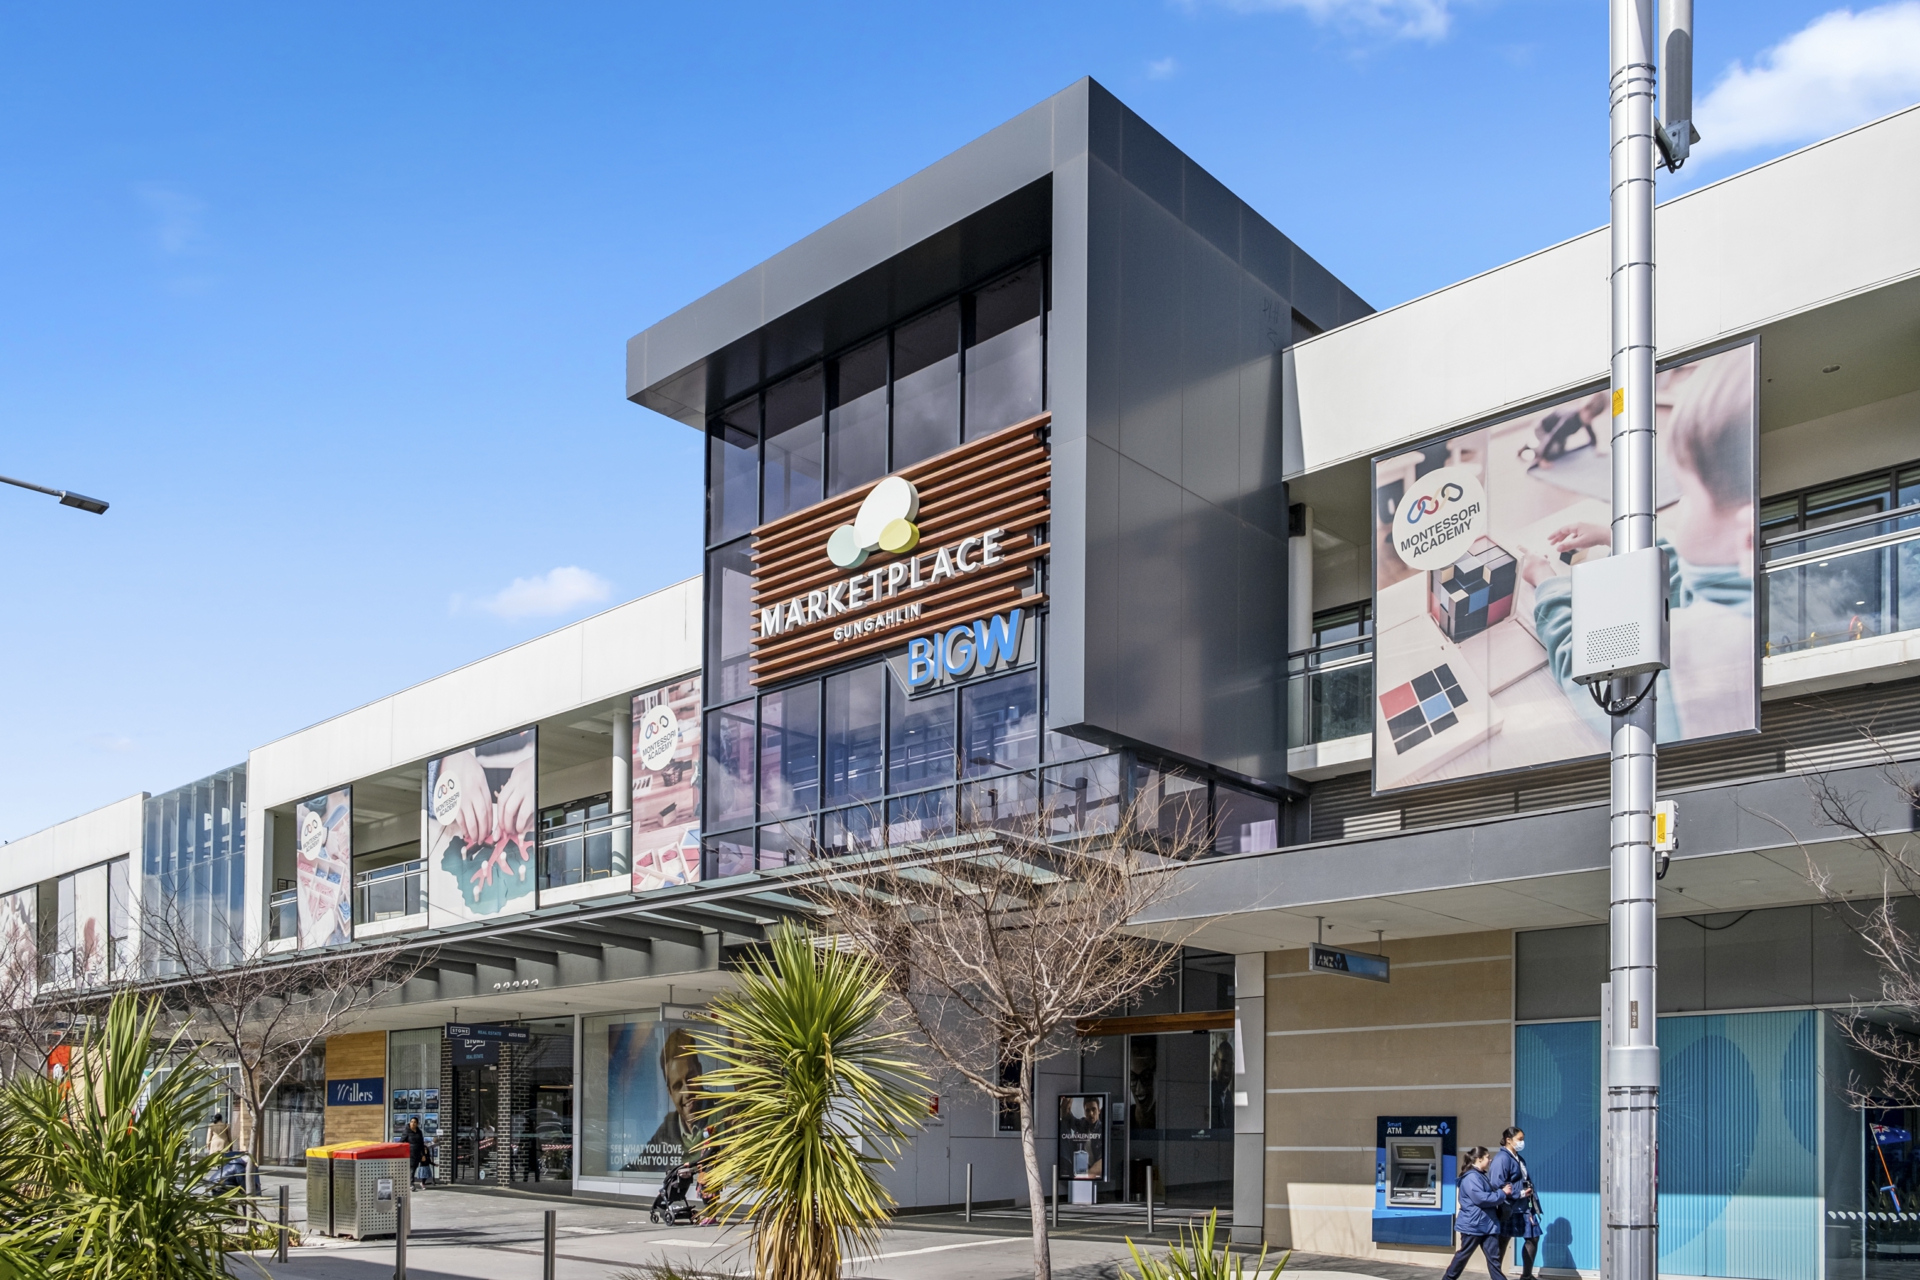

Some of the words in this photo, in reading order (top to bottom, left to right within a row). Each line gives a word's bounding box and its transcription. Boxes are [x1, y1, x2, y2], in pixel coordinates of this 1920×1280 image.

[1400, 502, 1481, 552] MONTESSORI
[1413, 519, 1472, 558] ACADEMY
[761, 527, 1005, 638] MARKETPLACE
[833, 603, 922, 641] GUNGAHLIN
[642, 729, 677, 757] MONTESSORI
[647, 740, 673, 761] ACADEMY
[1317, 954, 1334, 968] ANZ
[337, 1082, 373, 1102] Millers
[1414, 1125, 1438, 1135] ANZ
[610, 1144, 622, 1154] SEE
[623, 1144, 645, 1154] WHAT
[645, 1144, 660, 1154] YOU
[662, 1144, 685, 1156] LOVE,
[610, 1155, 628, 1165] LOVE
[630, 1156, 652, 1166] WHAT
[652, 1156, 668, 1166] YOU
